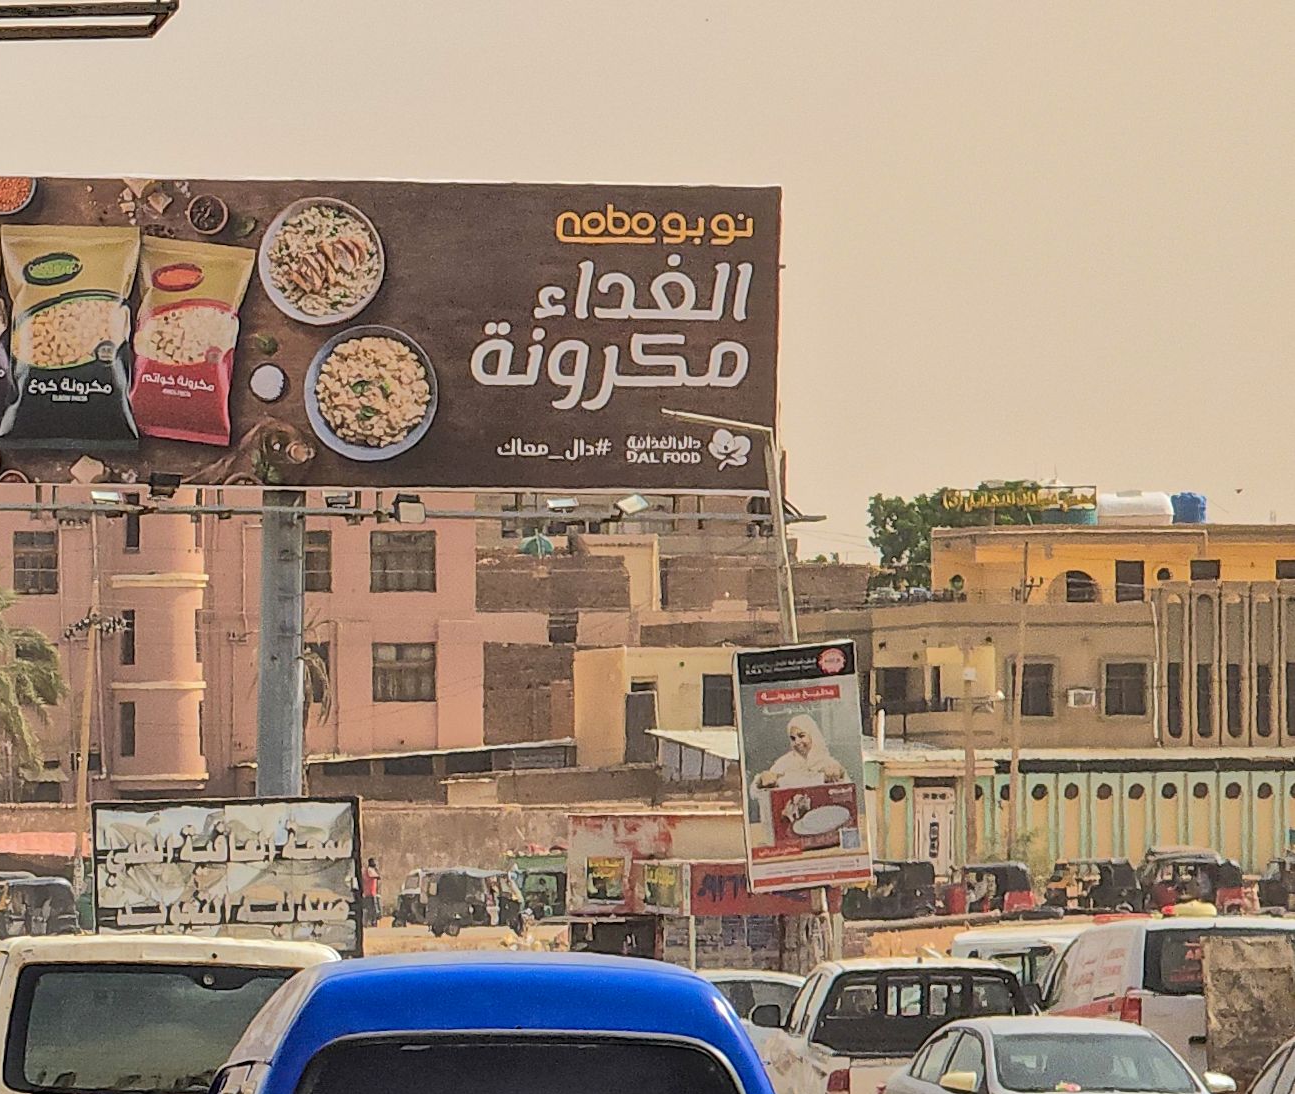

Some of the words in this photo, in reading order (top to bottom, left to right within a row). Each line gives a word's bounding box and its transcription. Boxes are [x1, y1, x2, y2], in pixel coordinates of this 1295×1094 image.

[556, 203, 656, 244] nobo
[534, 253, 753, 322] الغداء
[470, 321, 750, 411] مكرونة
[626, 450, 660, 464] DAL
[662, 450, 702, 464] FOOD
